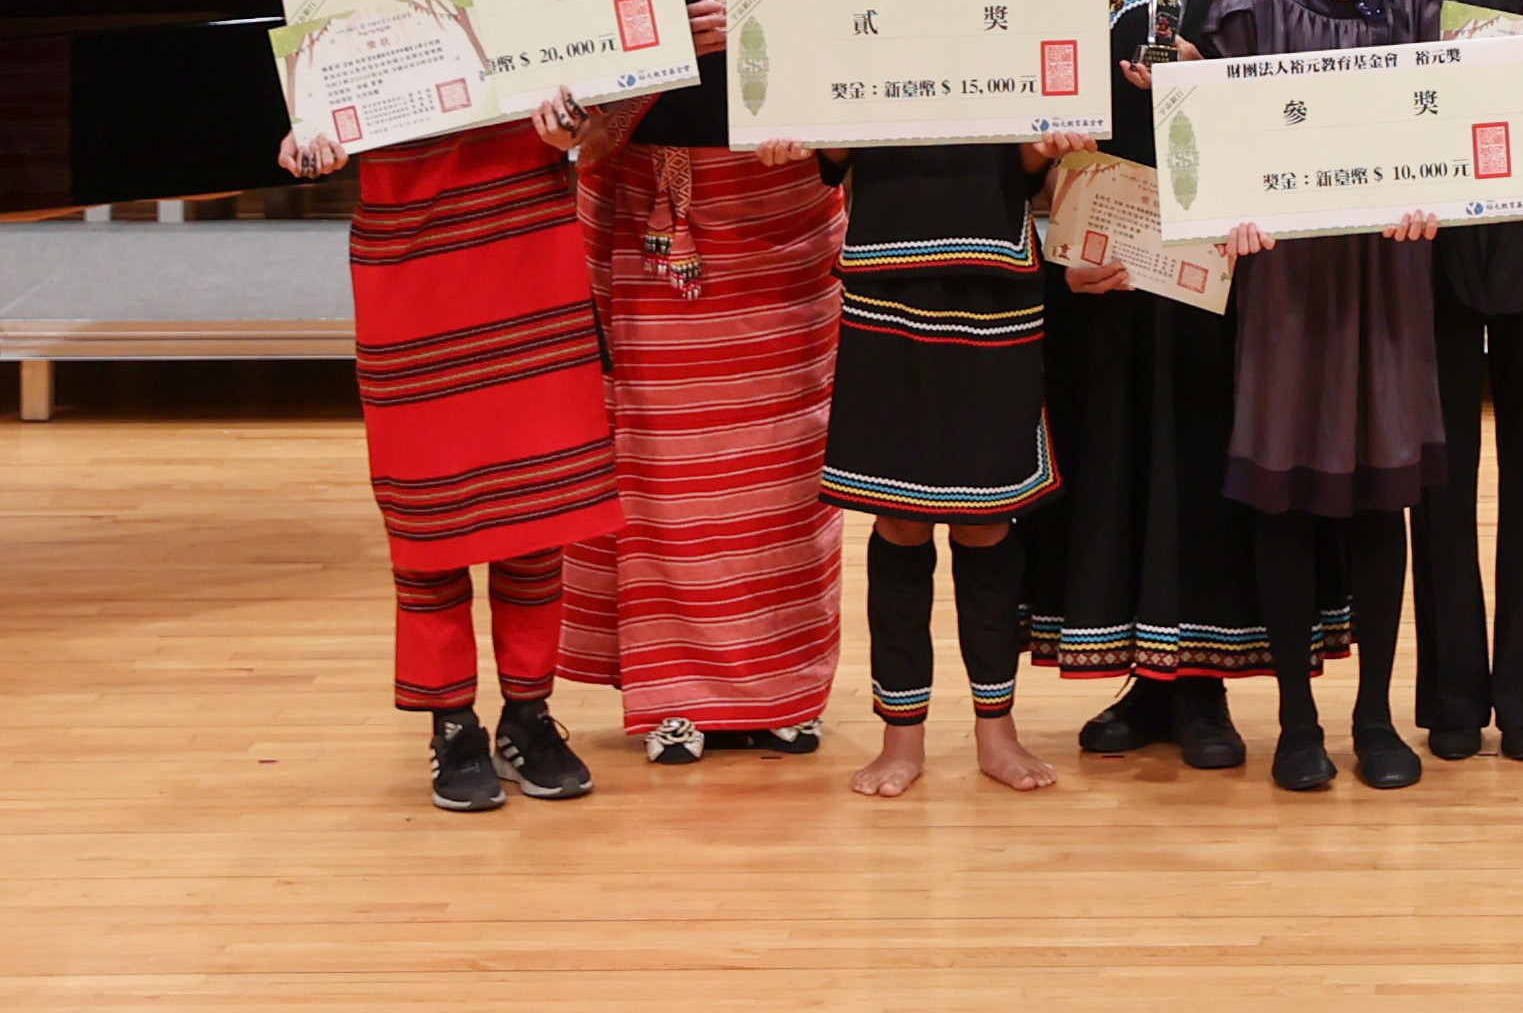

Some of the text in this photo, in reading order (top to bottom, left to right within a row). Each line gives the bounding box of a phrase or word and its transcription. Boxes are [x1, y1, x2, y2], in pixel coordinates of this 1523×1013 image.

[539, 40, 595, 64] 20,000
[598, 33, 618, 53] 元
[1226, 49, 1461, 79] 財團法人裕元教育基金會 裕元獎
[961, 77, 1015, 96] 15,000
[1020, 74, 1038, 94] 元
[1393, 162, 1448, 181] 10,000
[1452, 159, 1471, 178] 元
